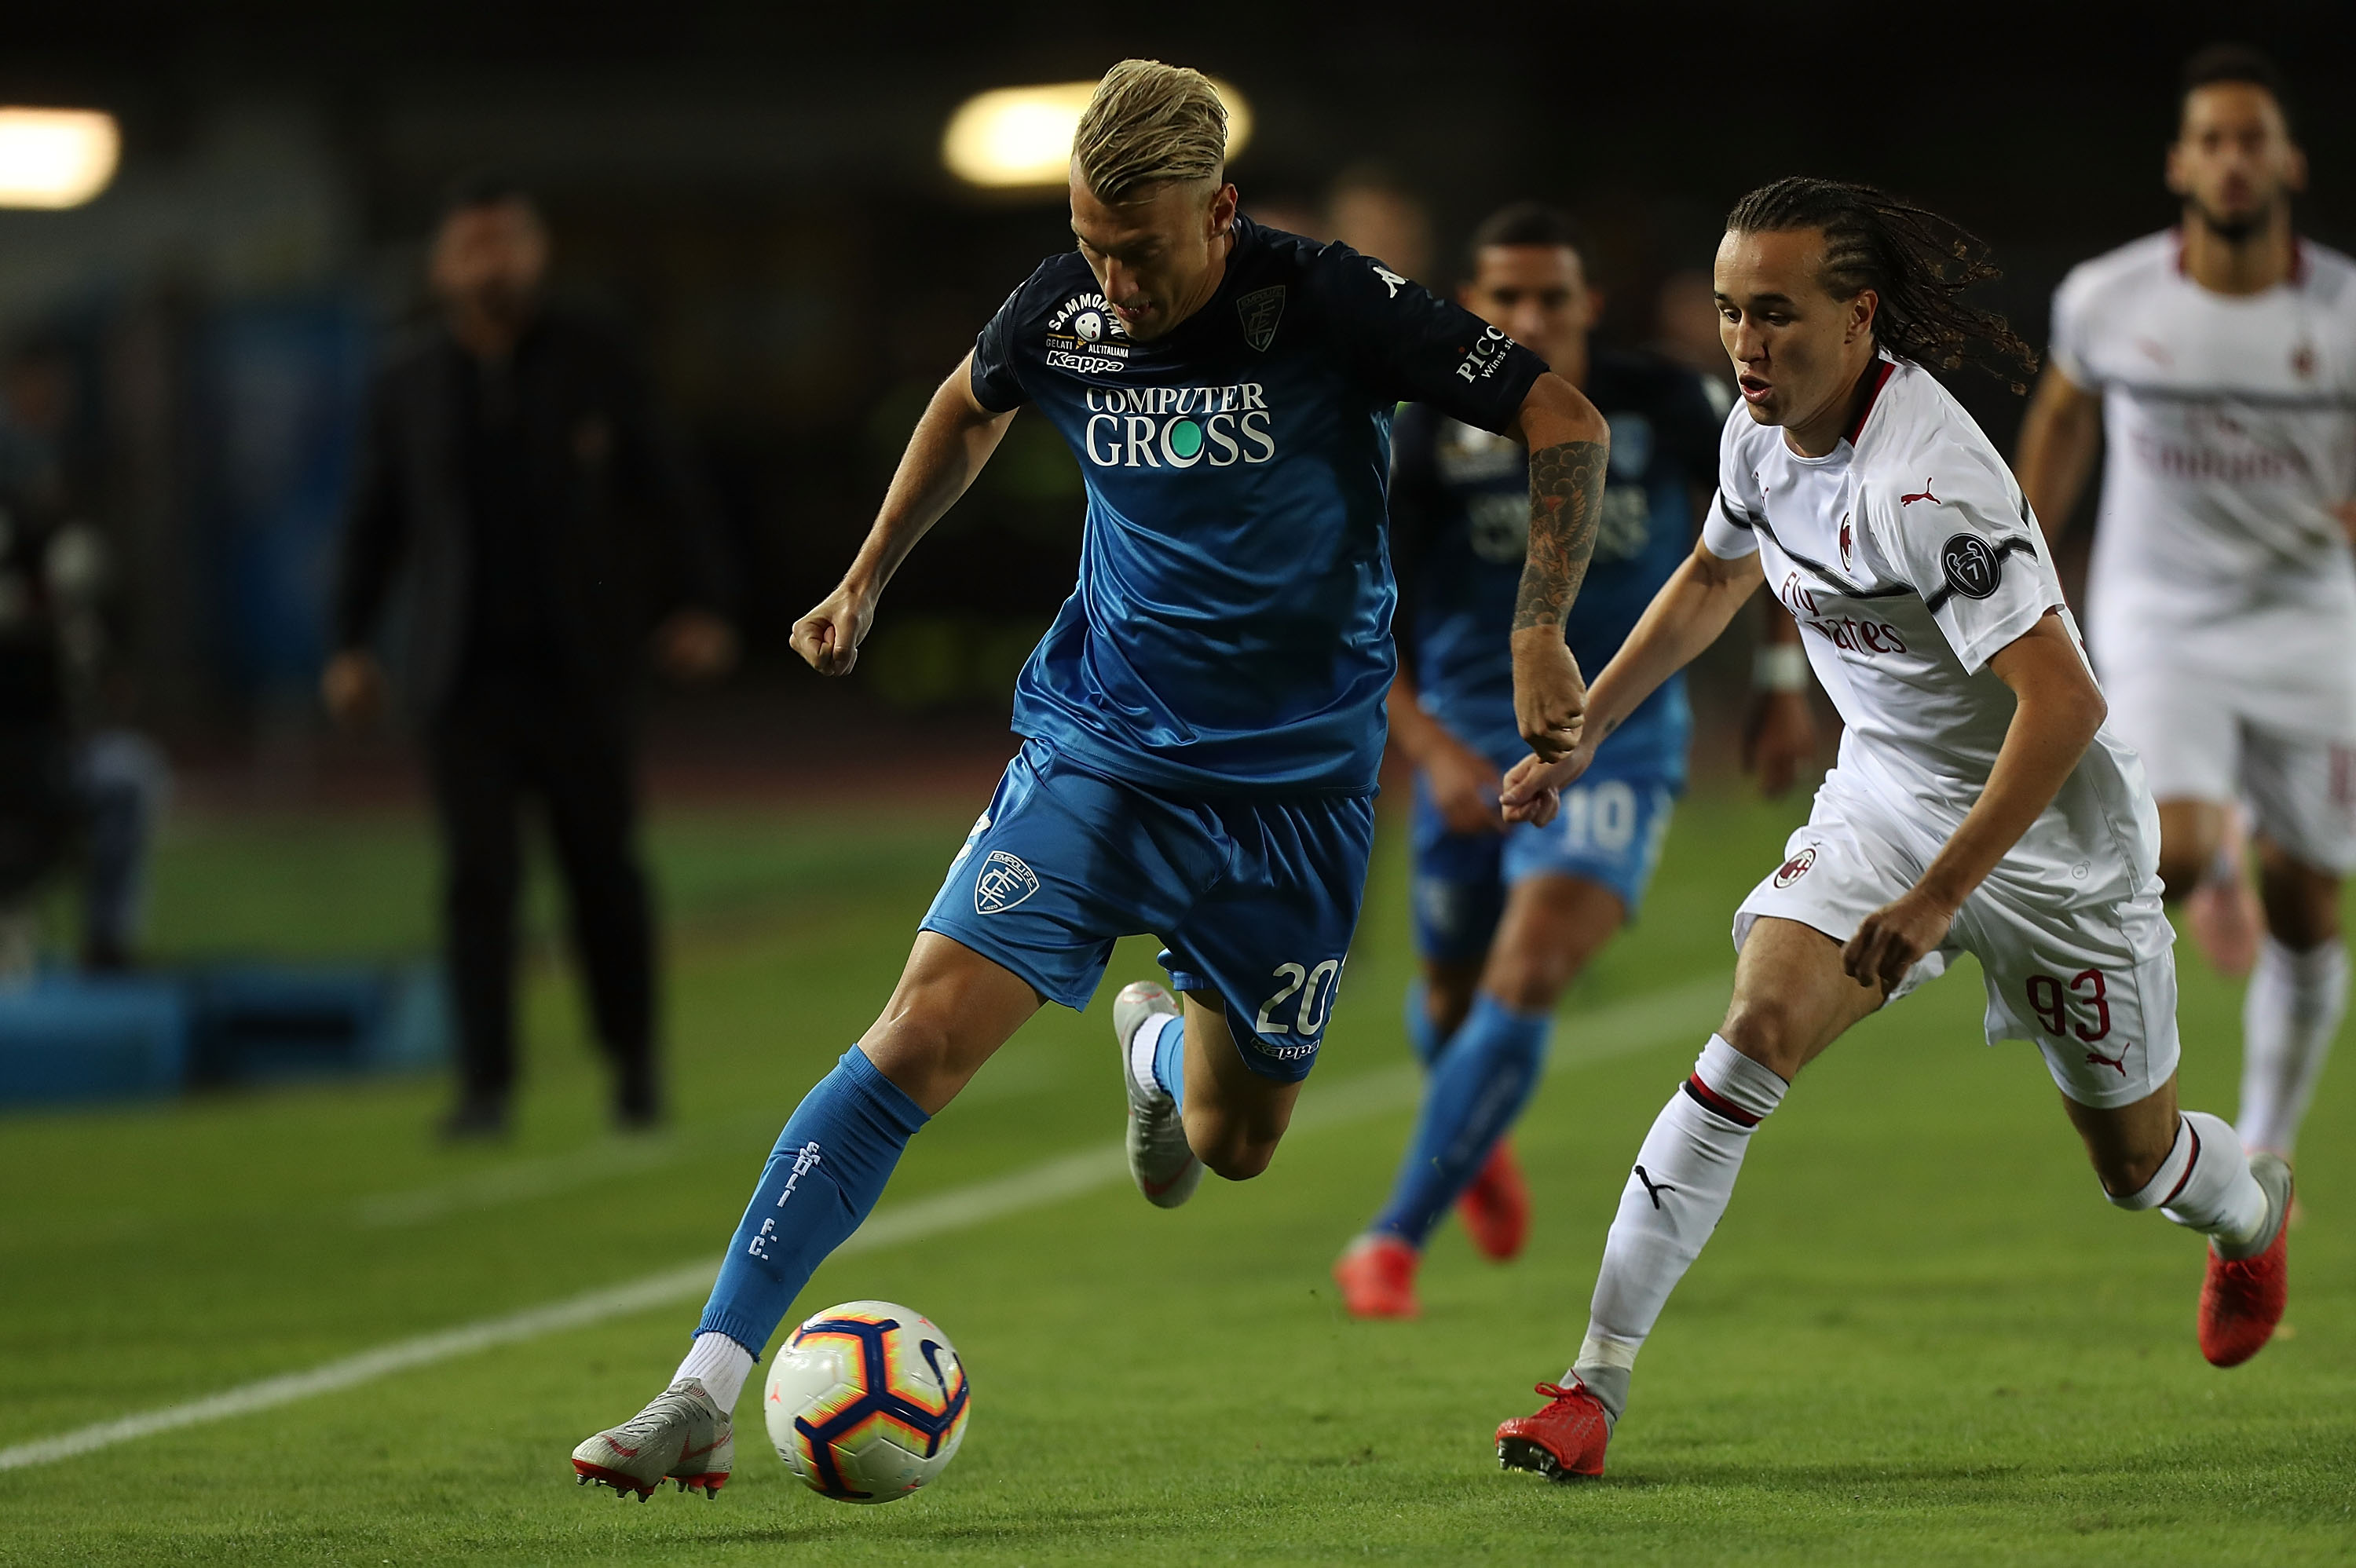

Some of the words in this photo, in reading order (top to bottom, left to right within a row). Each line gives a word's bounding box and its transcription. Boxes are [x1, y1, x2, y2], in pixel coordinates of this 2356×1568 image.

[1046, 338, 1073, 350] GELATI
[1088, 345, 1129, 358] ALL'ITALIANA
[1047, 350, 1125, 374] Kappa
[1481, 350, 1506, 378] Wines
[1086, 383, 1268, 415] COMPUTER
[1086, 411, 1275, 469] GROSS
[1966, 565, 1980, 581] 7
[1782, 571, 1820, 617] Fly
[1562, 780, 1637, 853] 10
[993, 853, 1026, 873] EMPOLI
[1257, 959, 1338, 1036] 20
[2026, 968, 2111, 1042] 93
